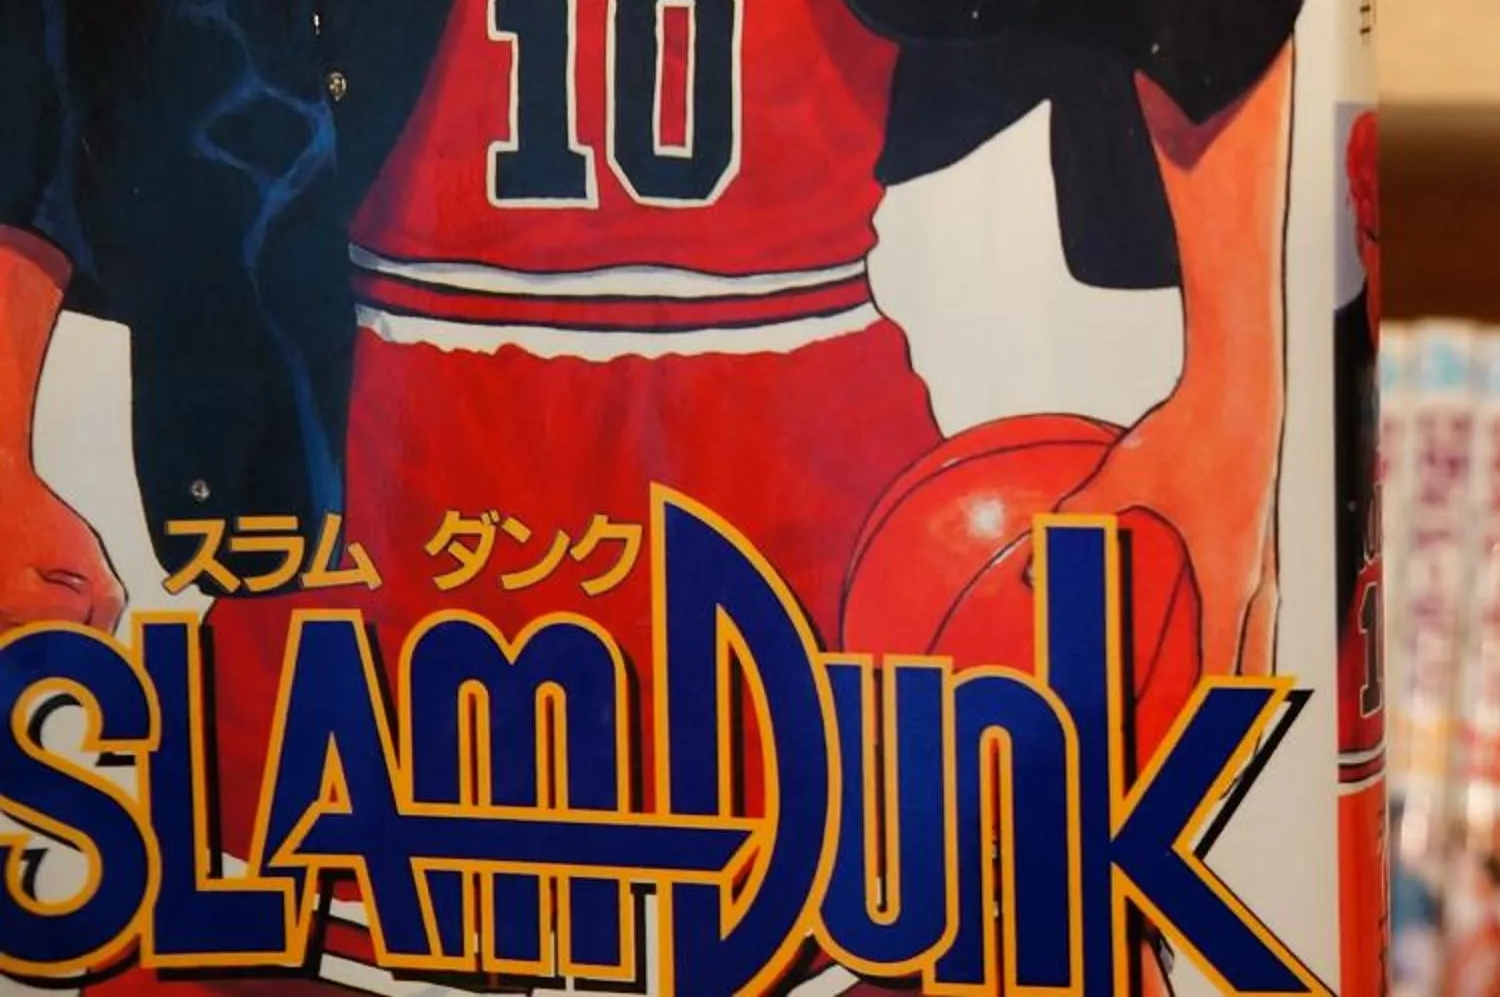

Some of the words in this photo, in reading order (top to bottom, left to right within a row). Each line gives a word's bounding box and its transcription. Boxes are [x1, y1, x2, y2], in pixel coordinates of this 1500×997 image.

[163, 511, 383, 596] スラム
[423, 508, 644, 597] ダンク
